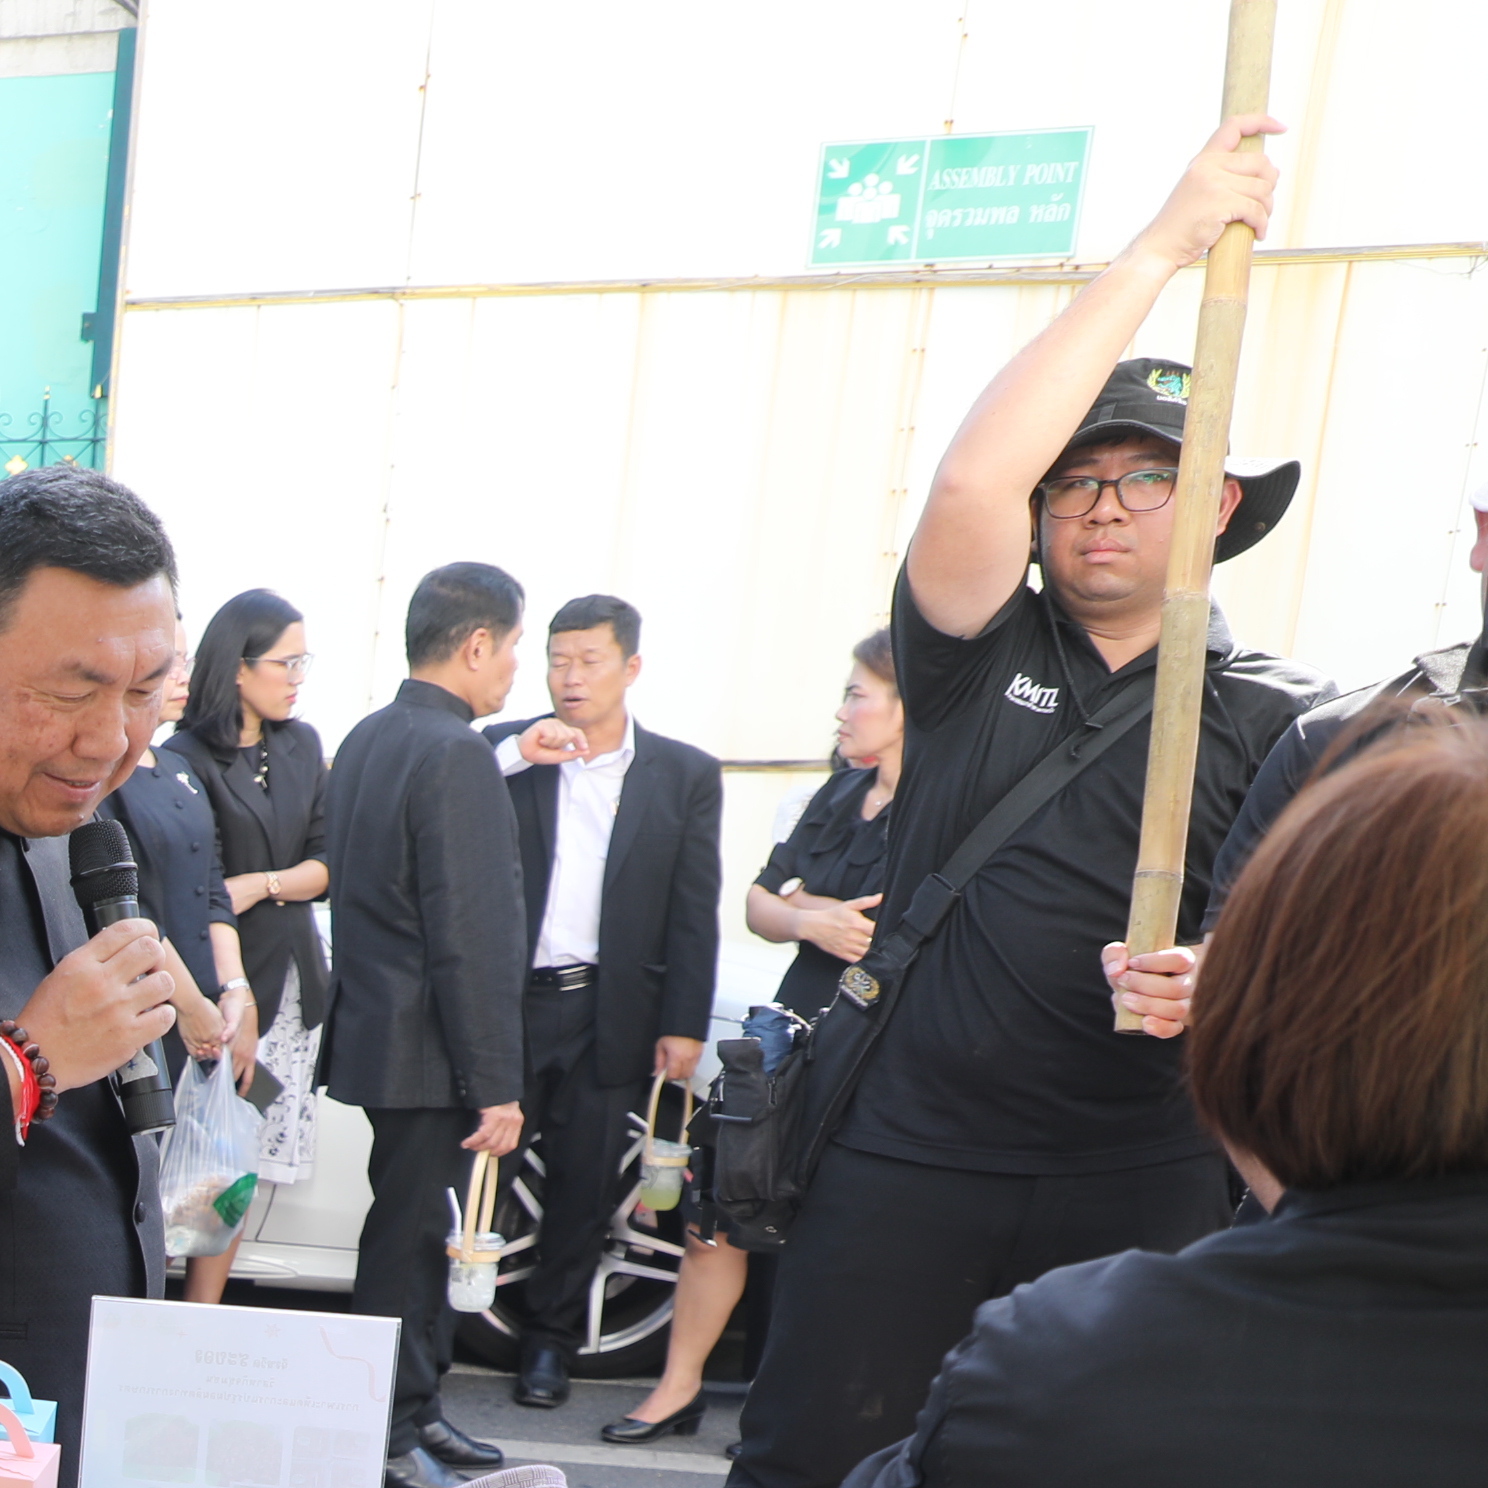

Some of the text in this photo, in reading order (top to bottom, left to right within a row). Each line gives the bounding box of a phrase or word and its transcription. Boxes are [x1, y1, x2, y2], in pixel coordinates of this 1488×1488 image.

[929, 162, 1079, 190] ASSEMBLY POINT
[925, 192, 1071, 240] จุดรวมพล หลัก
[1004, 672, 1060, 708] KMITL
